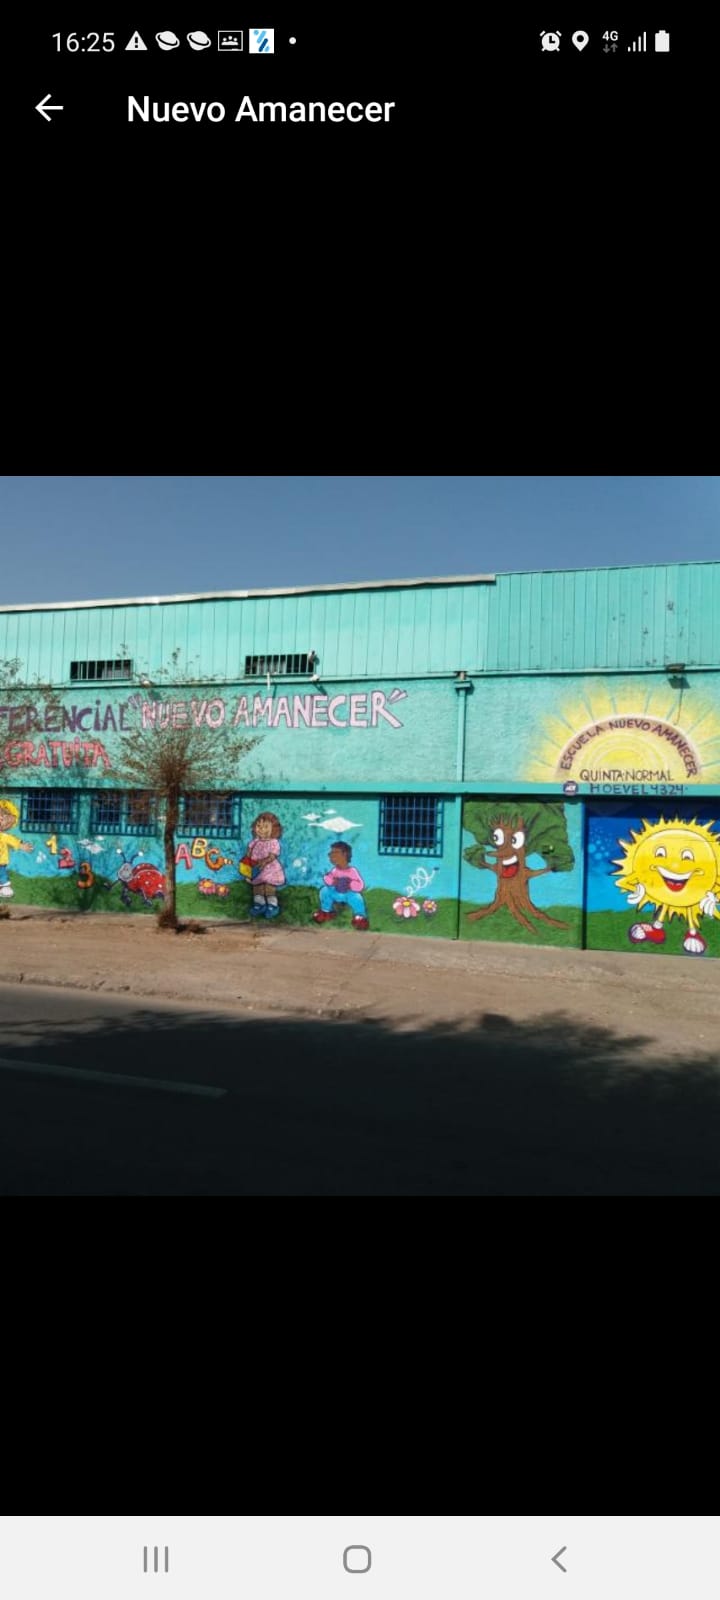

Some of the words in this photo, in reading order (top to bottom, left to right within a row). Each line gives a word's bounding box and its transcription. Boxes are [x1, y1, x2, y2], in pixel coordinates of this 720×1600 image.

[560, 724, 605, 770] ESCUELA
[608, 718, 650, 730] NUEVO
[652, 724, 698, 778] AMANECER
[590, 783, 648, 795] HOEVEL
